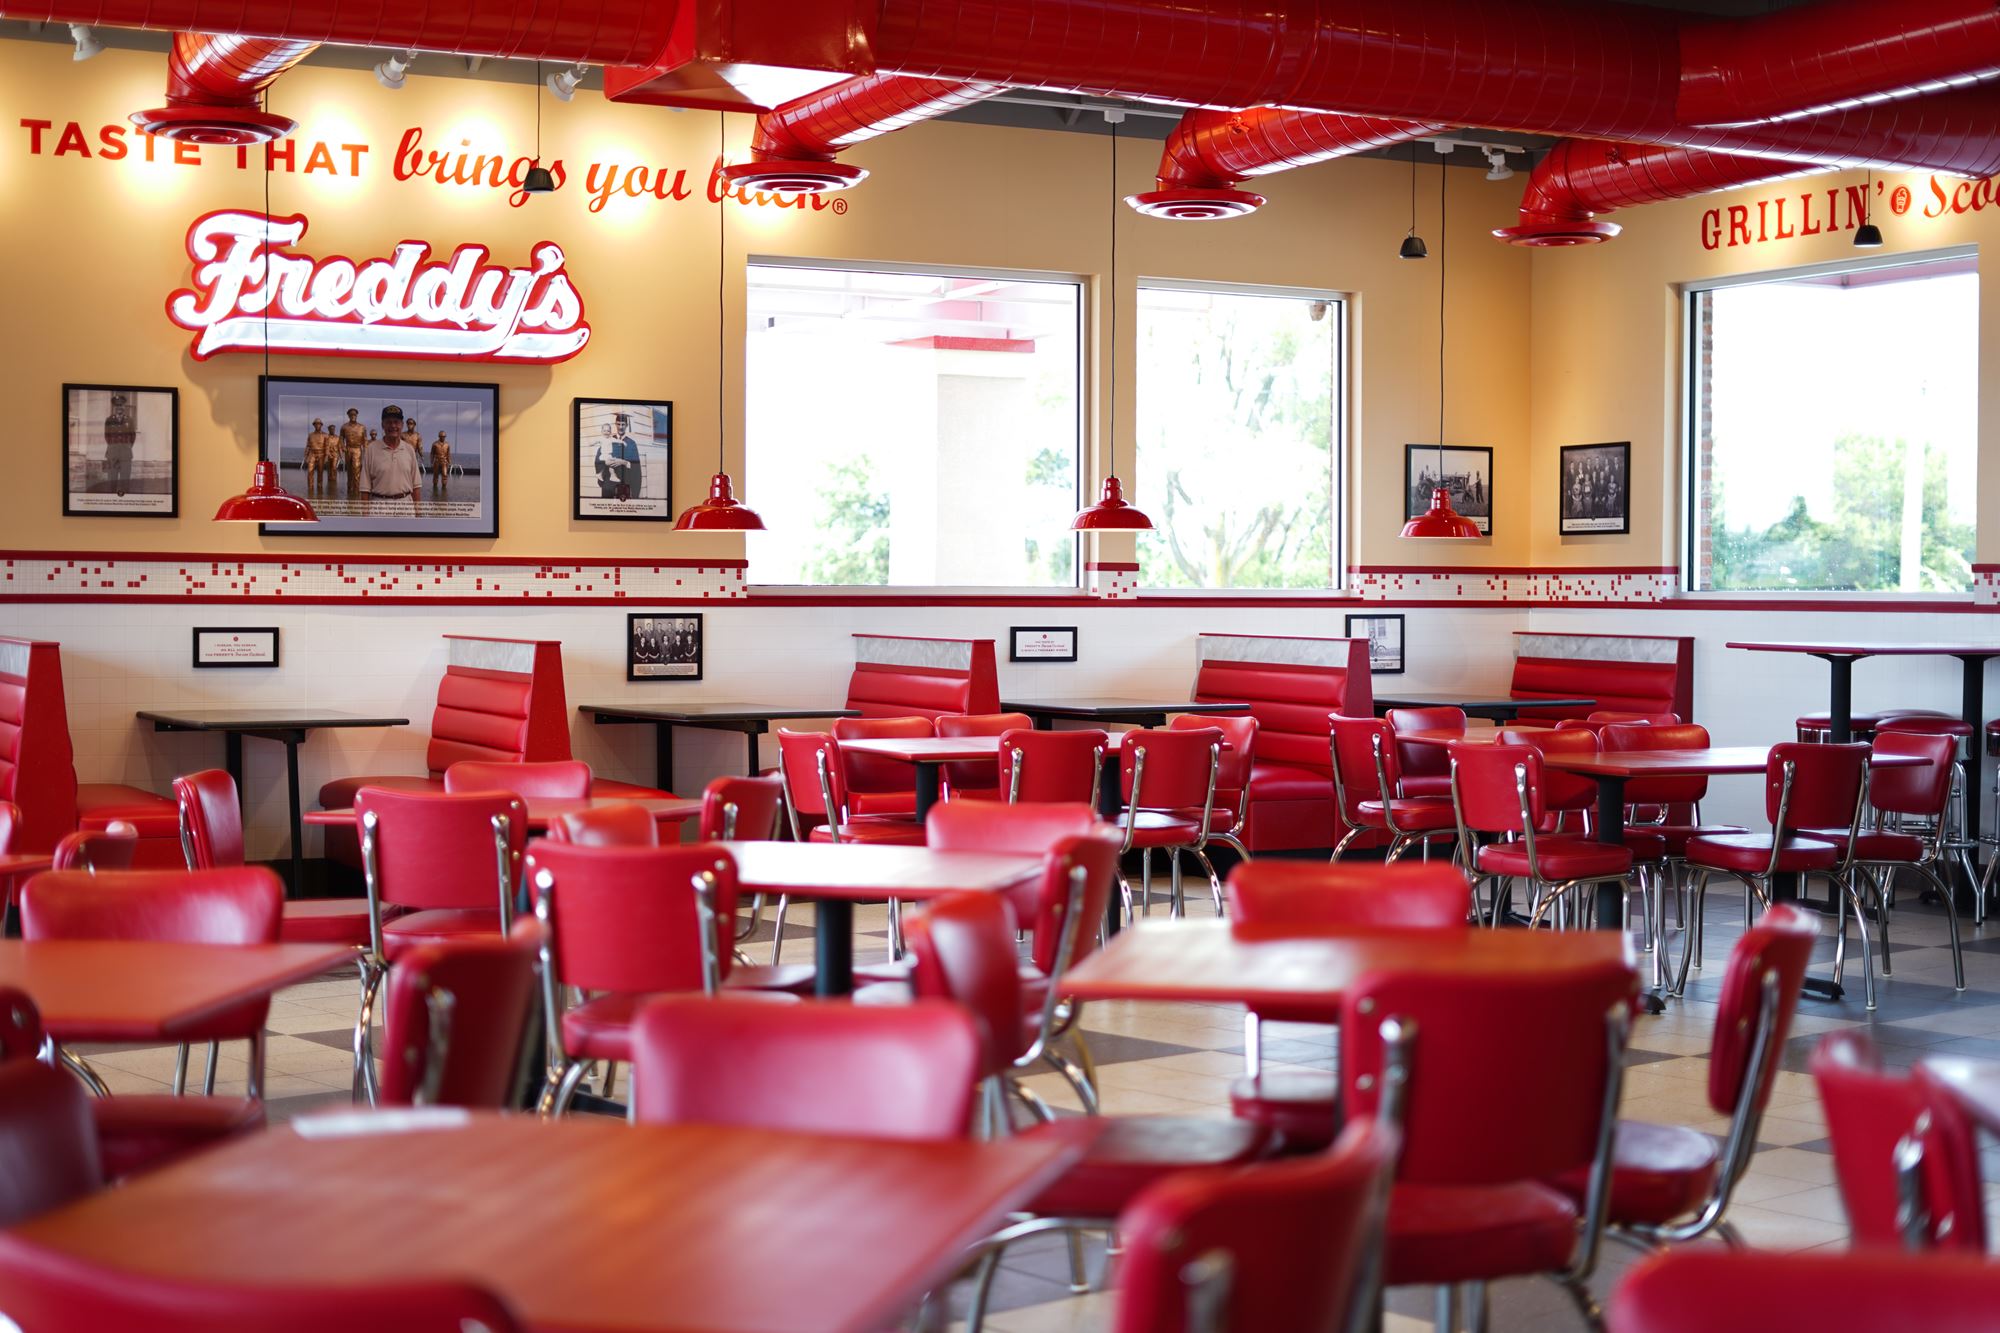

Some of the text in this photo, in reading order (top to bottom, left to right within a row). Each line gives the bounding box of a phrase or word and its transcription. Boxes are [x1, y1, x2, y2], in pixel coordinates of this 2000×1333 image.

[20, 118, 201, 166] TASTE
[393, 126, 567, 208] brings
[585, 158, 692, 213] you
[1701, 174, 2000, 251] GRILLIN' Sco
[168, 210, 591, 361] Freddy's
